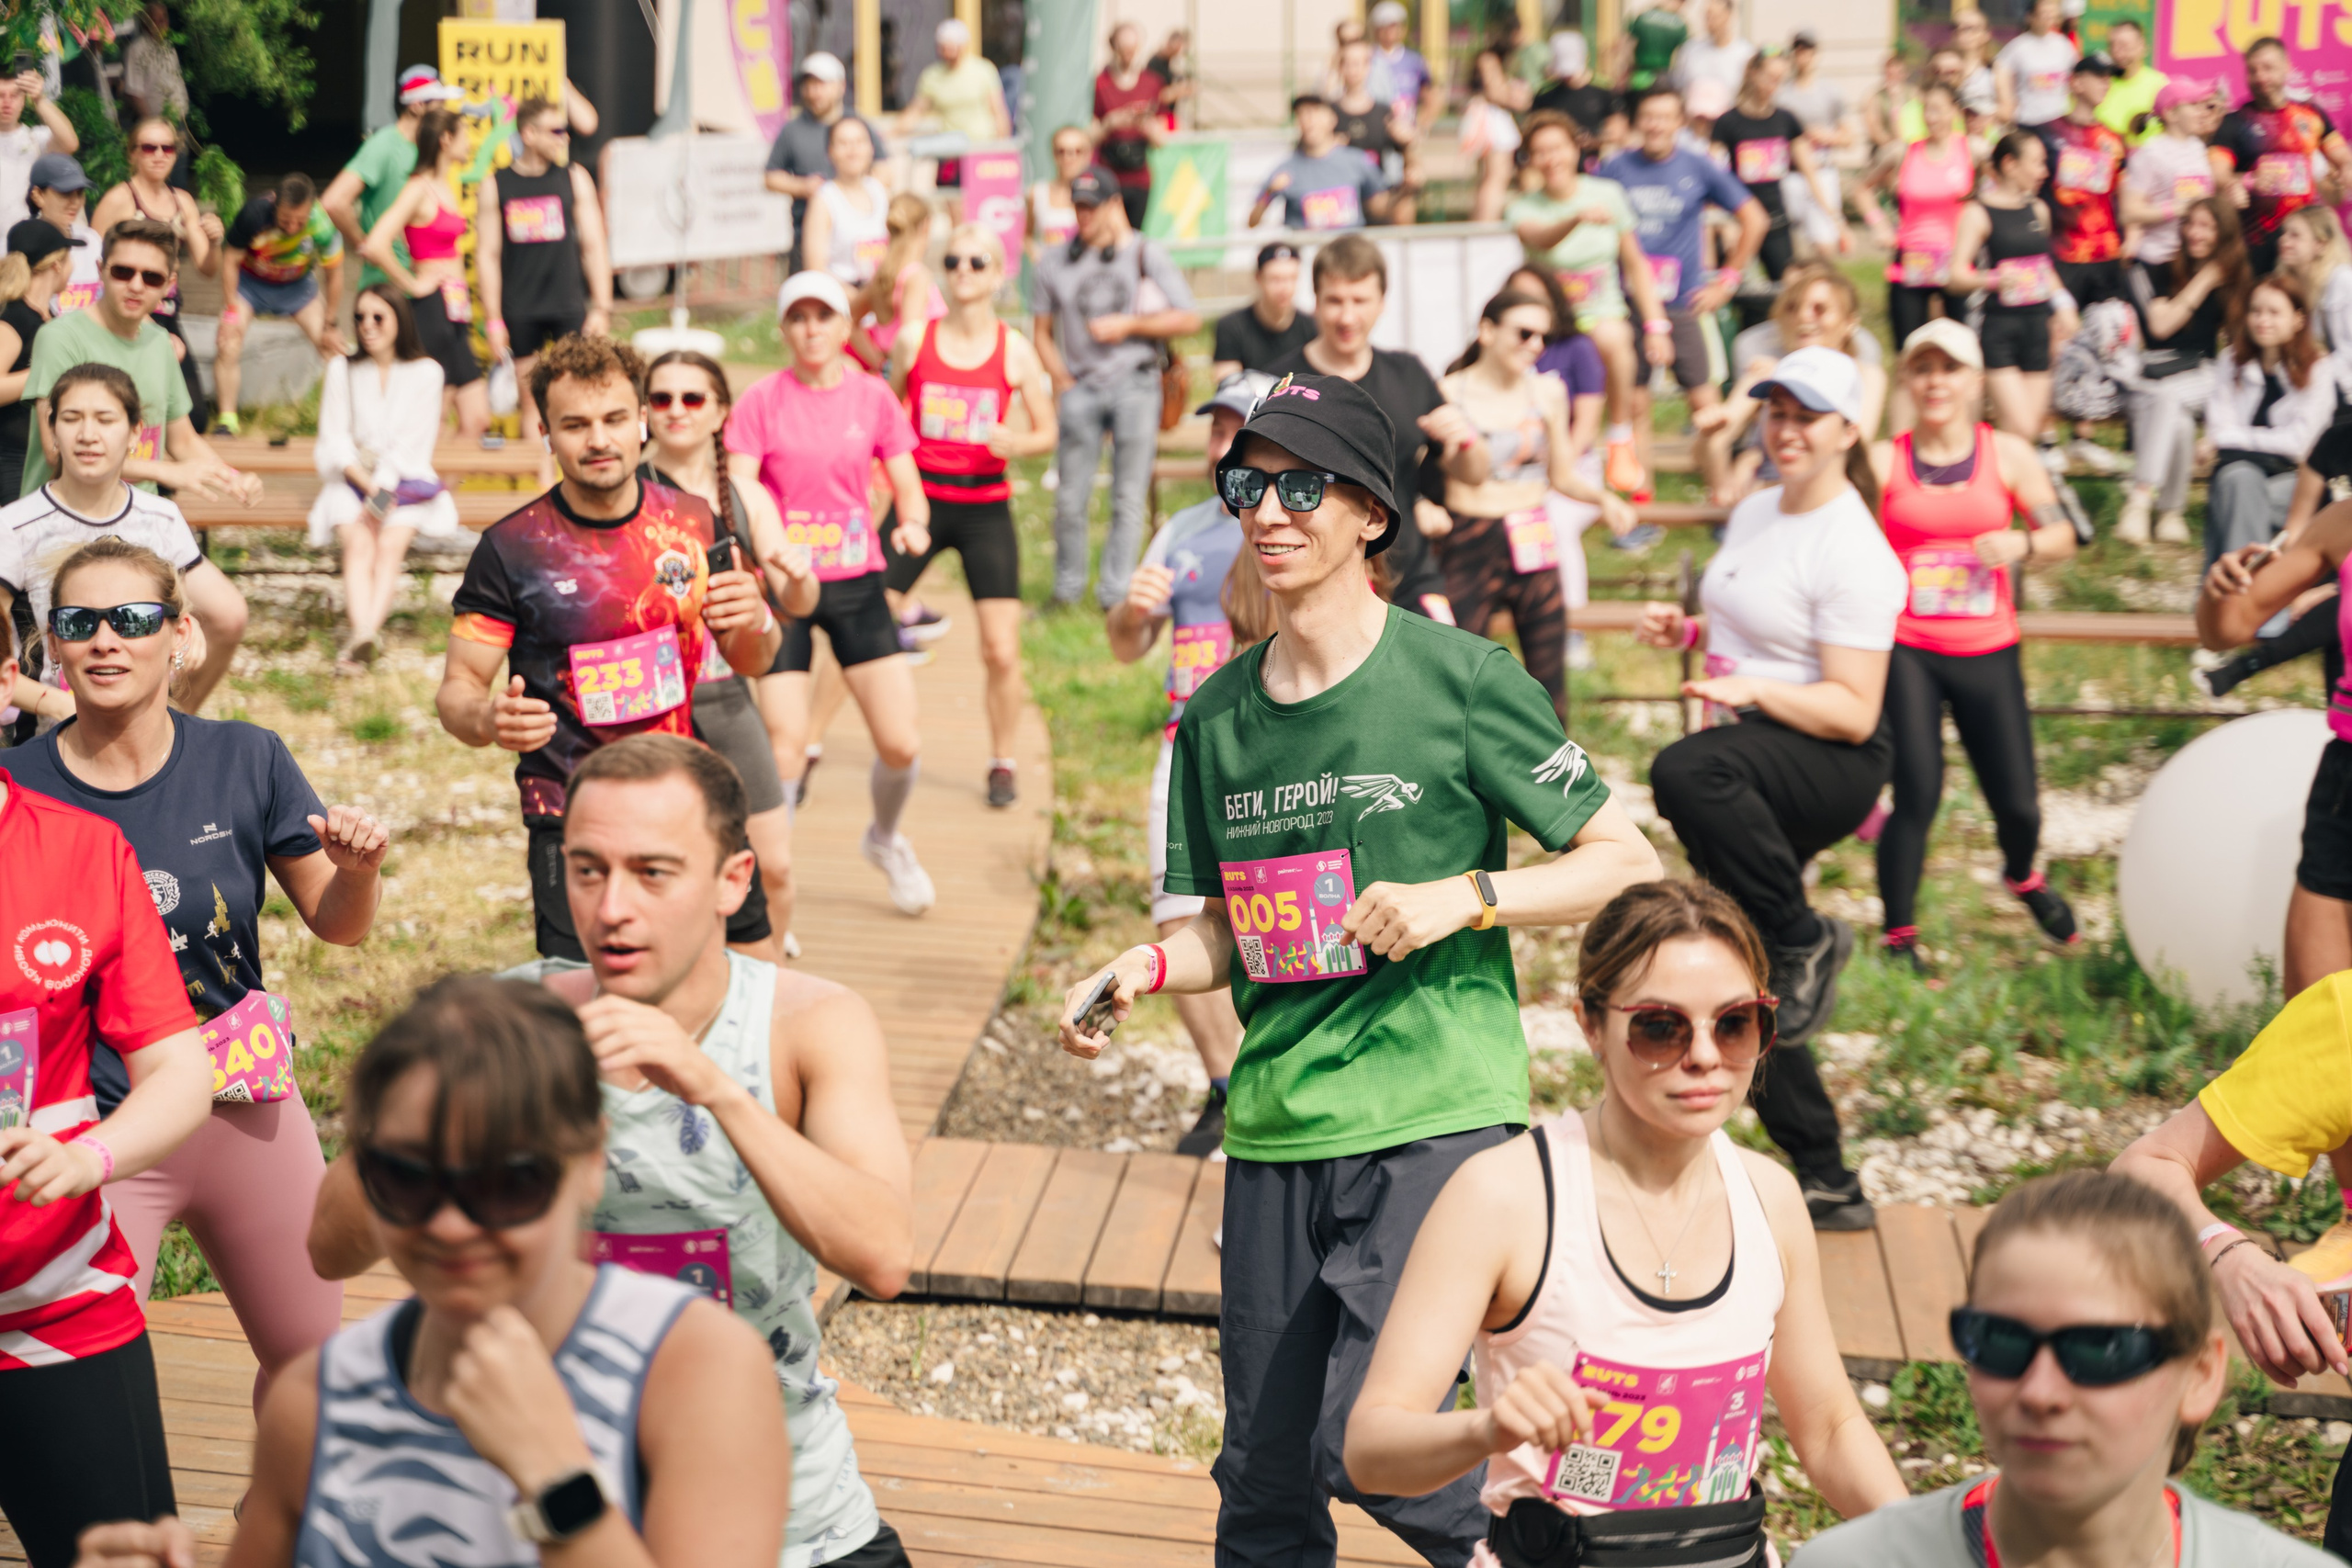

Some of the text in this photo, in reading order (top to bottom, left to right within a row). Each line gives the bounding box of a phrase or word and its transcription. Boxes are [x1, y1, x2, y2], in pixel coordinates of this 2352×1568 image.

[457, 41, 548, 64] RUN
[577, 658, 644, 695] 233
[1225, 772, 1340, 820] БЕГИ, ГЕРОЙ!
[1227, 810, 1334, 840] НИЖНИЙ НОВГОРОД 2023
[1224, 871, 1247, 882] RUTS
[1324, 878, 1334, 893] 1
[1229, 890, 1303, 934] 005
[691, 1268, 704, 1284] 1
[1582, 1364, 1639, 1389] RUTS
[1729, 1390, 1746, 1412] 3
[1573, 1401, 1682, 1455] 79
